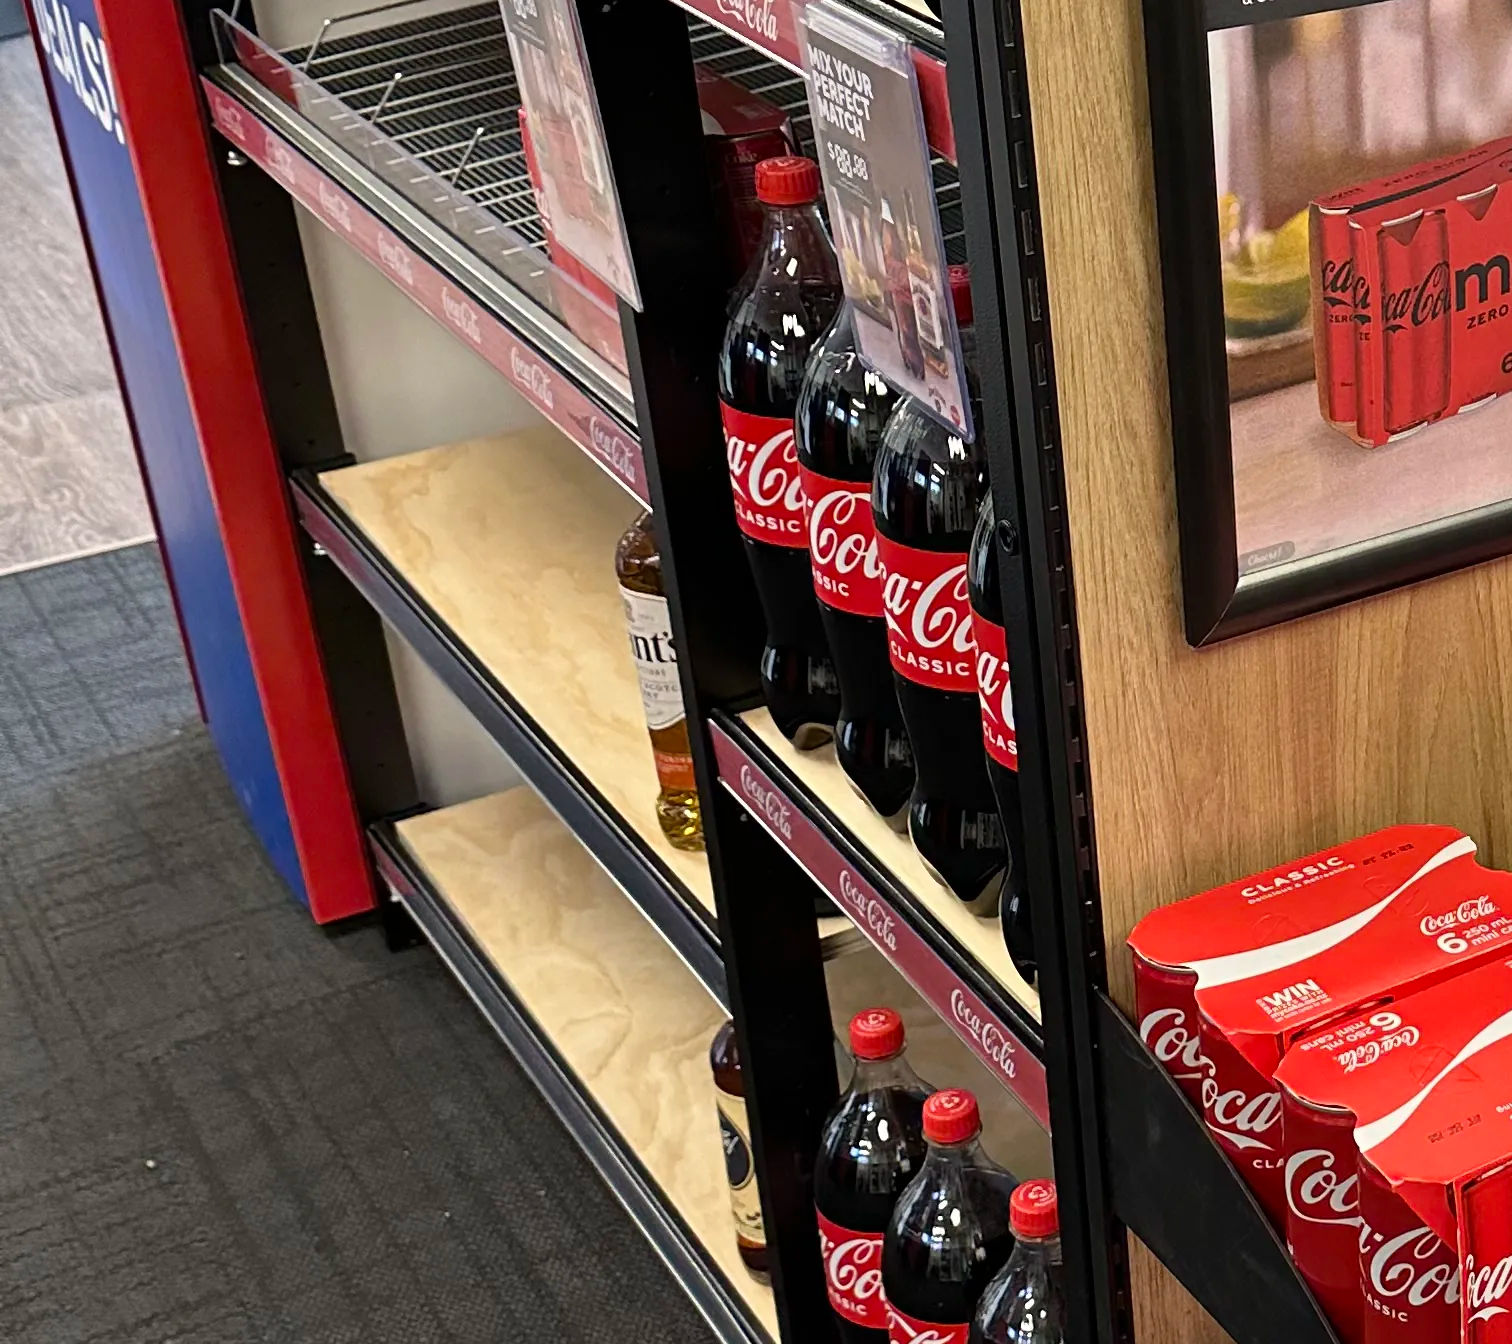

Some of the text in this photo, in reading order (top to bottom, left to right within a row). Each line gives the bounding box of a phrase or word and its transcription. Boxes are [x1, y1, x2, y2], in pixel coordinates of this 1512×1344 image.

[807, 42, 874, 100] MIX YOUR
[812, 69, 870, 121] PERFECT
[817, 94, 866, 142] MATCH
[1467, 303, 1508, 330] ZERO
[890, 640, 970, 676] CLASSIC
[740, 765, 793, 841] Coca-Cola
[1240, 856, 1344, 898] CLASSIC
[839, 869, 897, 952] Coca-Cola
[1420, 895, 1497, 936] Coca-Cola
[1462, 918, 1512, 940] 250 mL
[1436, 931, 1468, 954] 6
[1470, 931, 1499, 947] mini
[1262, 978, 1321, 1007] WIN
[951, 988, 1016, 1078] Coca-Cola
[1369, 1012, 1402, 1032] 6
[1336, 1026, 1421, 1074] Coca-Cola
